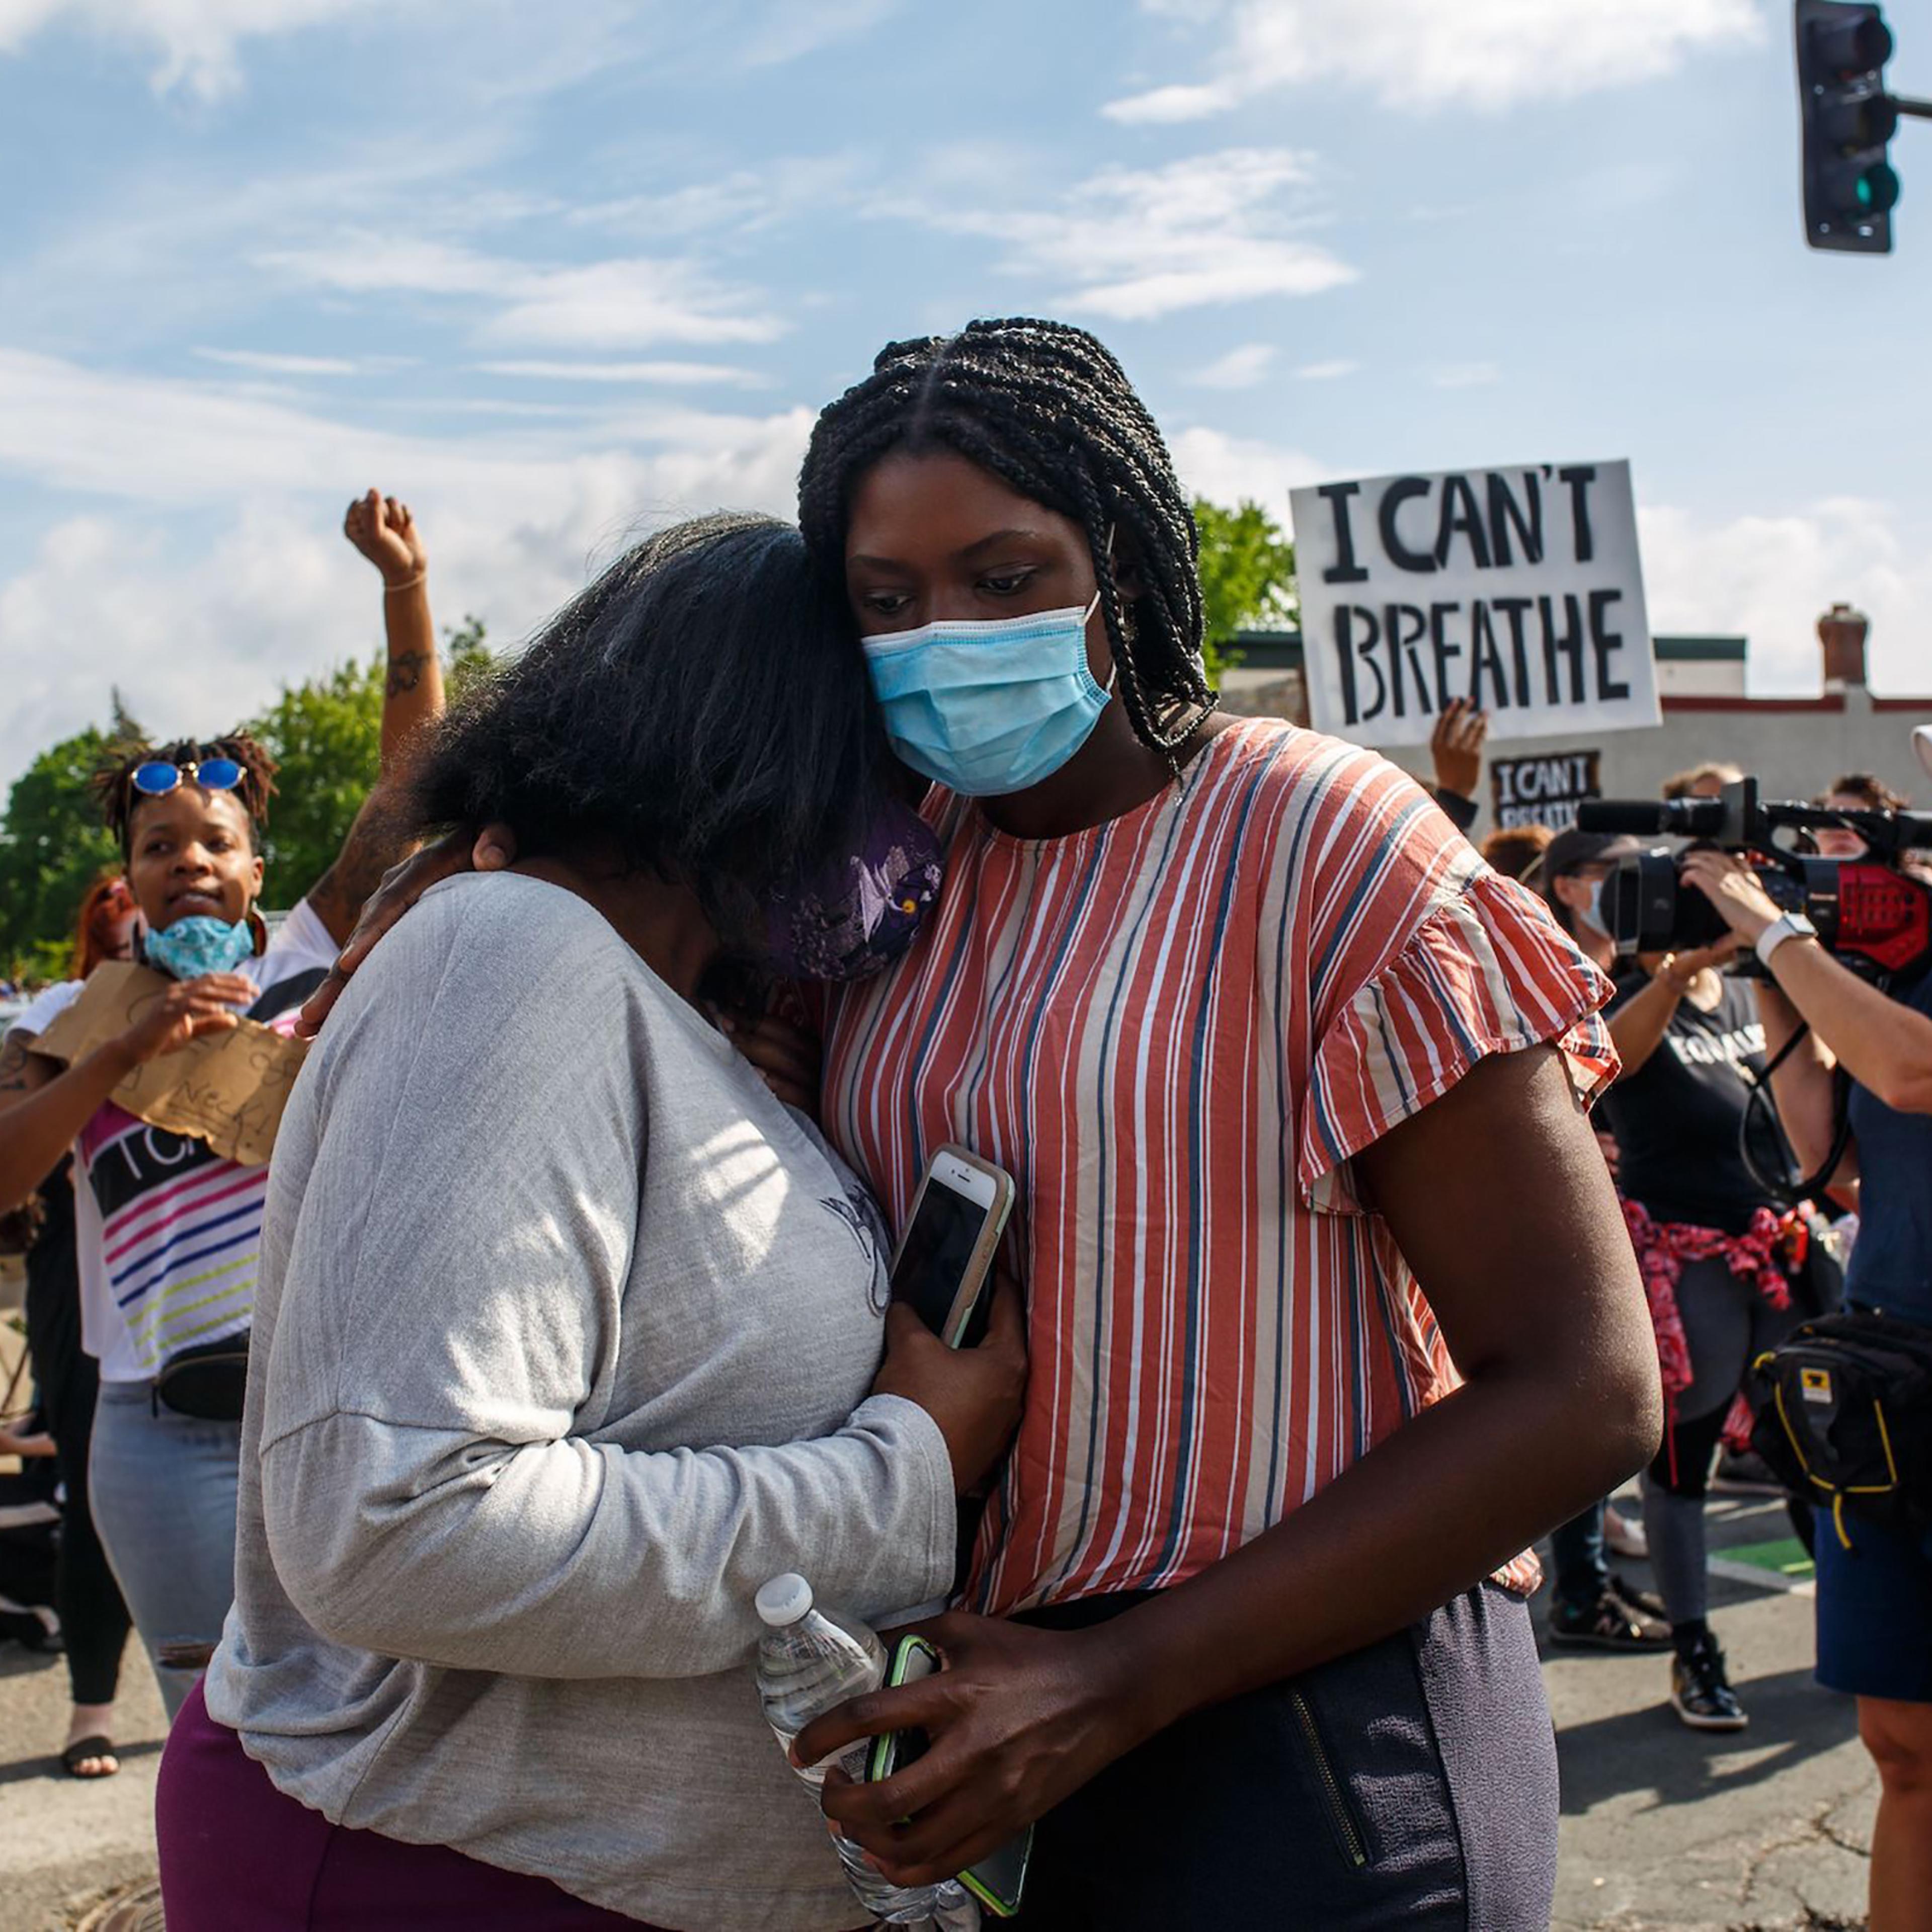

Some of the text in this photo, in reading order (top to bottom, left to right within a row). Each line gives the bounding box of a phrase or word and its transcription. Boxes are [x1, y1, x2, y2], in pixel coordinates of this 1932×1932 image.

[1318, 464, 1596, 584] I CAN'T
[1334, 589, 1630, 726] BREATHE
[1497, 764, 1515, 804] I
